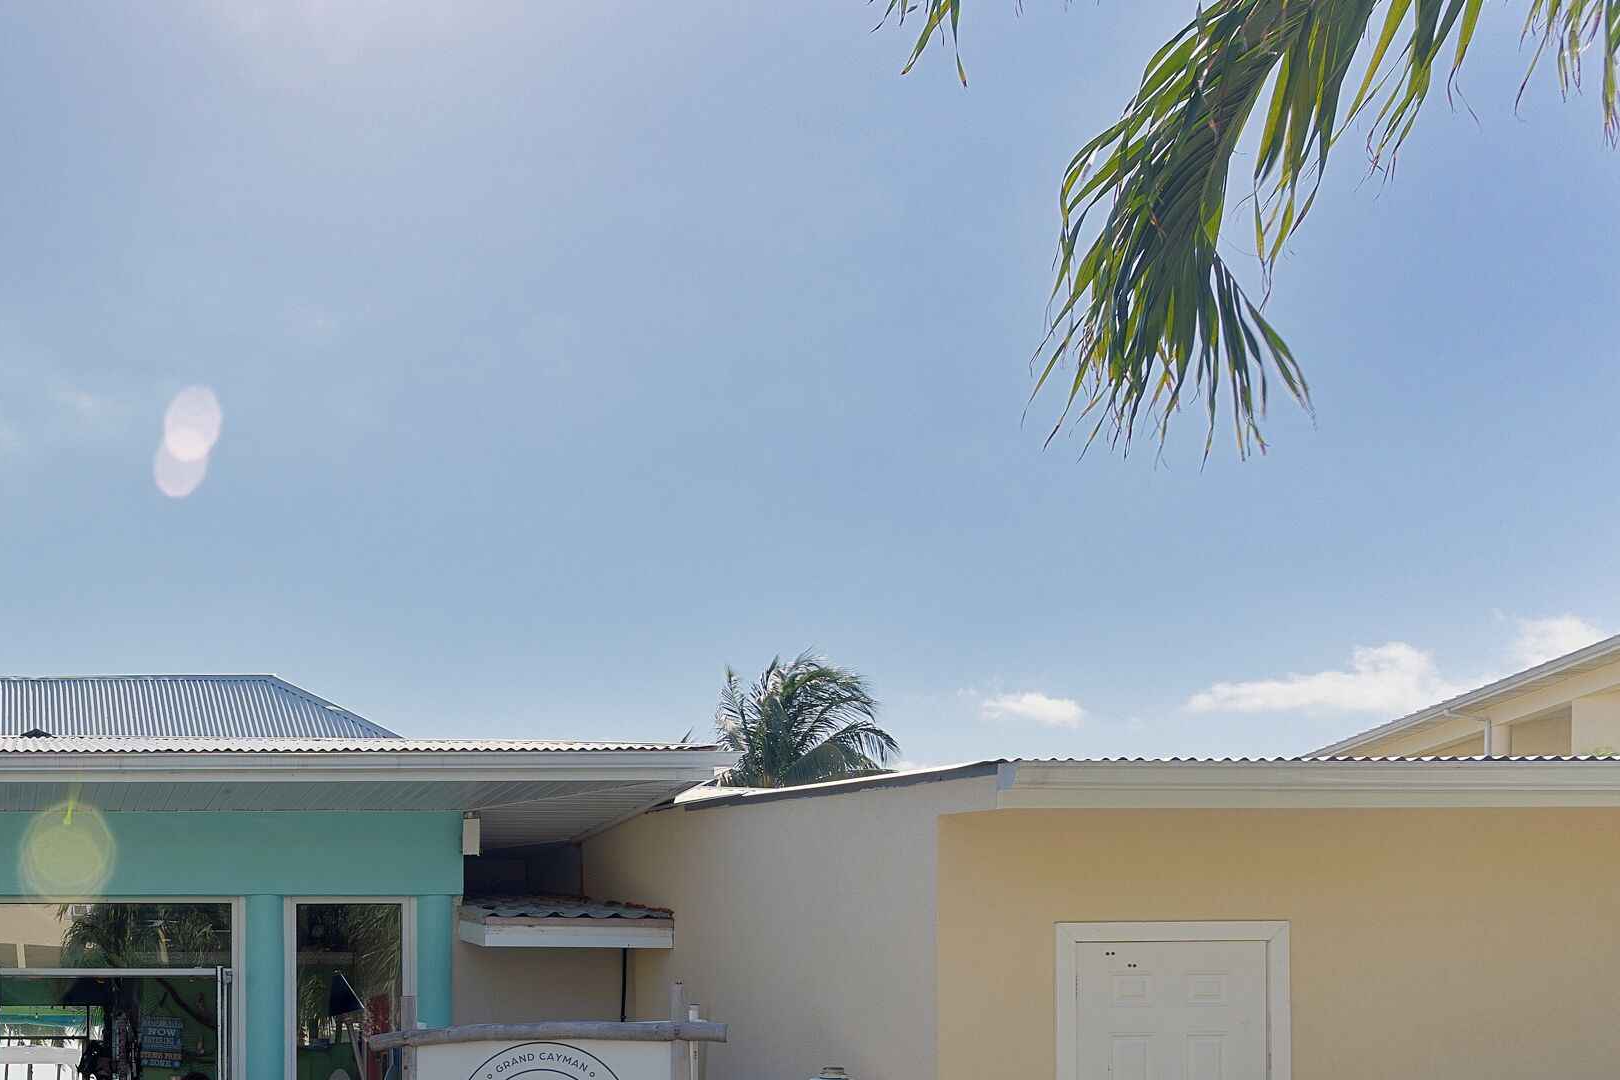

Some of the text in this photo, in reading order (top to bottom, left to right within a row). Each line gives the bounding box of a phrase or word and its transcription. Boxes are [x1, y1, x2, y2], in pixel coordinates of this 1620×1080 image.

[147, 1028, 176, 1036] NOW
[149, 1059, 172, 1067] ZONE
[495, 1051, 589, 1073] GRAND CAYMAN
